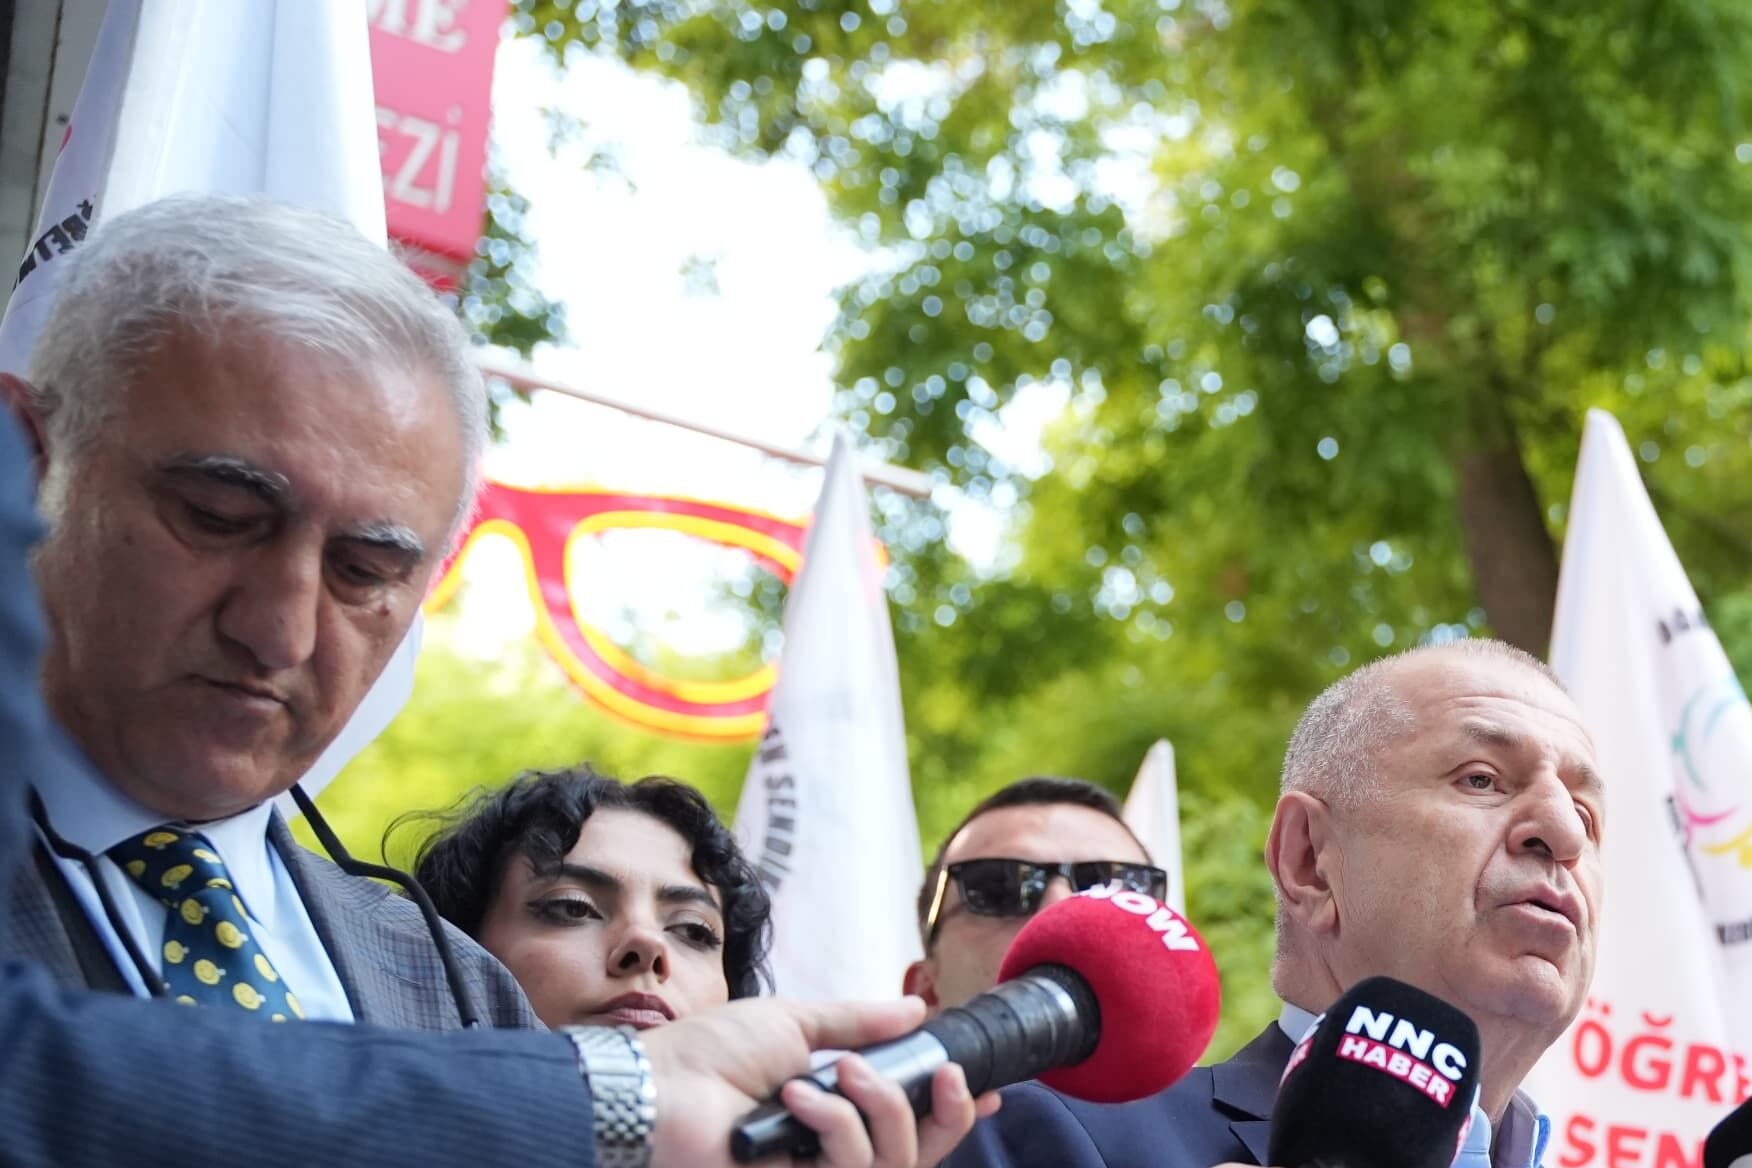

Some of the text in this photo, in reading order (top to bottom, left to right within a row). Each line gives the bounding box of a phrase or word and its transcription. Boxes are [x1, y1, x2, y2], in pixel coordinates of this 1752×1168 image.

[1074, 878, 1200, 952] NOW
[1341, 1038, 1453, 1106] HABER
[1345, 1005, 1467, 1082] NNC
